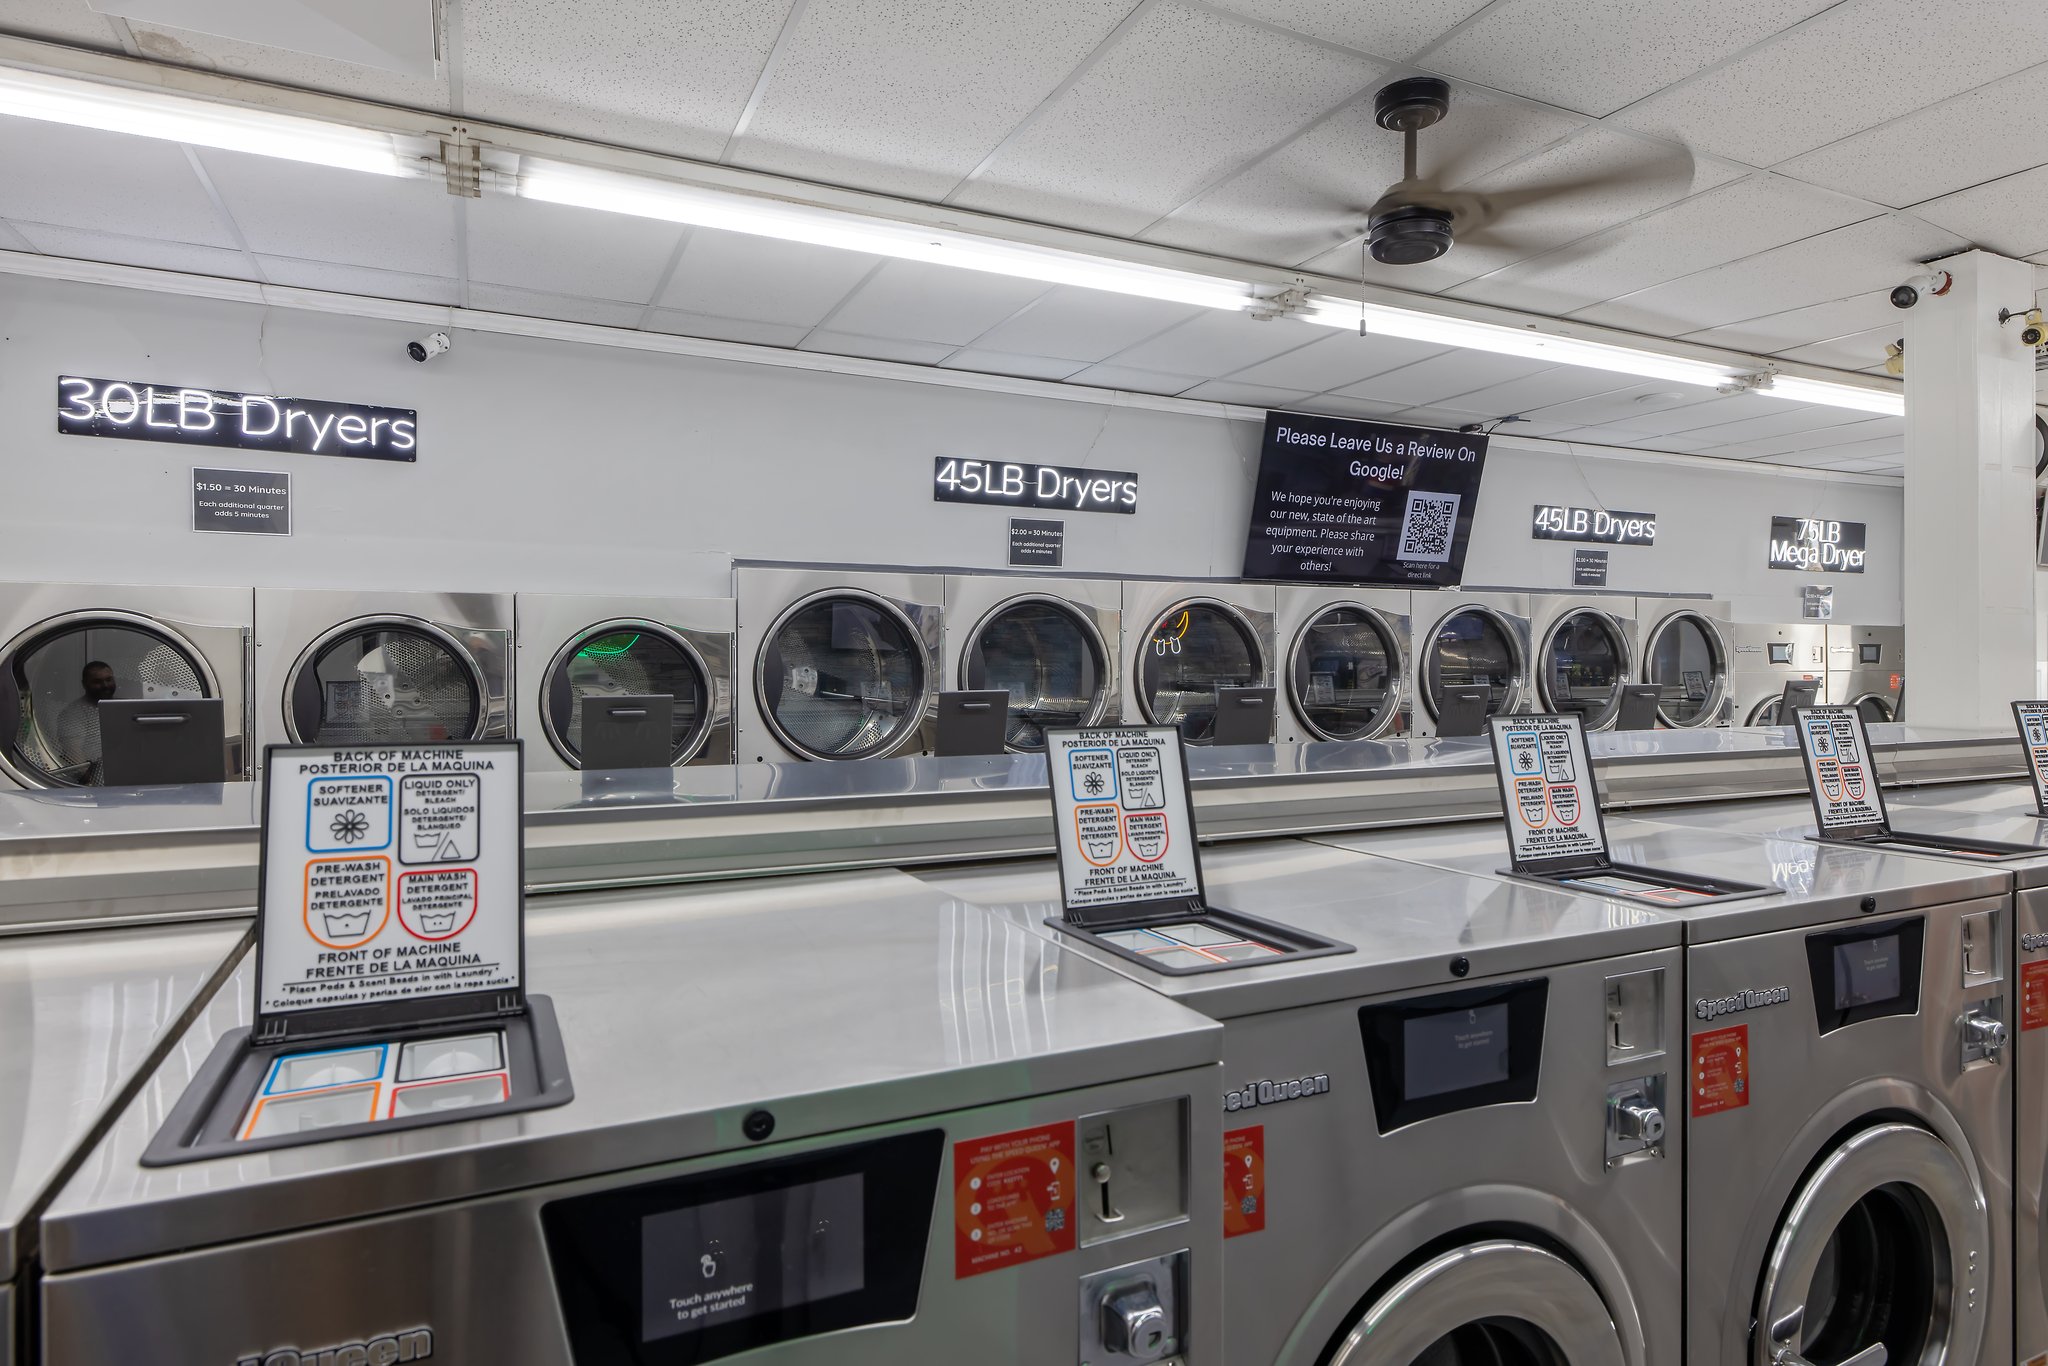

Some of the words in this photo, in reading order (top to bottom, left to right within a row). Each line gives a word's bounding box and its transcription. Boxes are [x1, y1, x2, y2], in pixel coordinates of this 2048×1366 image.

[60, 378, 216, 431] 30LB
[241, 395, 415, 451] Dryers
[1276, 426, 1326, 447] Please
[1330, 432, 1371, 451] Leave
[1375, 437, 1393, 454] Us
[1396, 443, 1404, 455] a
[1408, 441, 1455, 460] Review
[1458, 446, 1476, 462] On
[1349, 460, 1404, 482] Google!
[196, 482, 222, 491] $1.50
[234, 484, 246, 493] 30
[248, 485, 287, 495] Minutes
[937, 460, 1024, 496] 45LB
[1037, 467, 1137, 508] Dryers
[1271, 490, 1286, 503] We
[1288, 492, 1312, 507] hope
[1313, 495, 1342, 508] you're
[1344, 497, 1381, 511] enjoying
[1270, 510, 1286, 520] our
[1288, 511, 1310, 522] new,
[1312, 512, 1334, 523] state
[1336, 512, 1347, 524] of
[1347, 513, 1361, 524] the
[1363, 516, 1376, 525] art
[1535, 507, 1588, 534] 45LB
[1594, 511, 1656, 542] Dryers
[1266, 526, 1318, 538] equipment.
[1320, 528, 1349, 540] Please
[1350, 530, 1375, 541] share
[1796, 519, 1841, 544] 75LB
[1271, 543, 1292, 556] your
[1294, 545, 1343, 558] experience
[1345, 546, 1364, 557] with
[1770, 540, 1818, 569] Mega
[1822, 543, 1866, 571] Dryer
[1300, 560, 1332, 572] others!
[1079, 732, 1101, 740] BACK
[1103, 731, 1113, 739] OF
[1115, 730, 1148, 738] MACHINE
[1062, 739, 1107, 748] POSTERIOR
[1109, 739, 1119, 747] DE
[1132, 738, 1166, 746] MAQUINA
[334, 752, 375, 763] BACK
[379, 751, 397, 762] OF
[402, 750, 464, 761] MACHINE
[300, 762, 383, 775] POSTERIOR
[387, 762, 405, 772] DE
[410, 761, 428, 772] LA
[432, 760, 494, 771] MAQUINA
[1073, 762, 1112, 770] SUAVIZANTE
[319, 784, 383, 795] SOFTENER
[404, 780, 443, 790] LIQUID
[446, 779, 475, 788] ONLY
[313, 795, 388, 806] SUAVIZANTE
[425, 796, 456, 804] BLEACH
[404, 807, 429, 815] SOLO
[432, 806, 475, 814] LIQUIDOS
[1080, 808, 1114, 816] PRE-WASH
[417, 822, 461, 830] BLANQUEO
[1079, 816, 1117, 824] DETERGENT
[1129, 822, 1162, 830] DETERGENT
[1080, 832, 1119, 840] DETERGENTE
[316, 862, 380, 874] PRE-WASH
[1089, 867, 1116, 876] FRONT
[1118, 866, 1128, 874] OF
[1130, 863, 1164, 873] MACHINE
[311, 873, 385, 886] DETERGENT
[409, 874, 434, 884] MAIN
[438, 872, 467, 882] WASH
[1085, 877, 1116, 886] FRENTE
[1117, 876, 1127, 884] DE
[1141, 871, 1176, 881] MAQUINA
[315, 887, 380, 899] PRELAVADO
[407, 883, 468, 894] DETERGENT
[310, 898, 383, 910] DETERGENTE
[402, 895, 432, 904] LAVADO
[434, 893, 473, 901] PRINCIPAL
[413, 901, 463, 911] DETERGENTE
[318, 950, 369, 964] FRONT
[373, 949, 392, 959] OF
[397, 942, 461, 957] MACHINE
[306, 964, 365, 979] FRENTE
[370, 962, 388, 973] DE
[394, 960, 412, 971] LA
[416, 954, 481, 969] MAQUINA
[290, 986, 316, 994] Place
[359, 979, 386, 987] Scent
[389, 976, 418, 984] Beads
[433, 971, 452, 980] with
[455, 968, 492, 978] Laundry
[273, 998, 313, 1008] Coloque
[316, 993, 358, 1003] capsulas
[369, 988, 398, 999] perlas
[464, 980, 483, 988] ropa
[669, 1294, 702, 1310] Touch
[703, 1283, 754, 1302] anywhere
[677, 1309, 689, 1320] to
[690, 1305, 708, 1319] get
[709, 1296, 746, 1312] started
